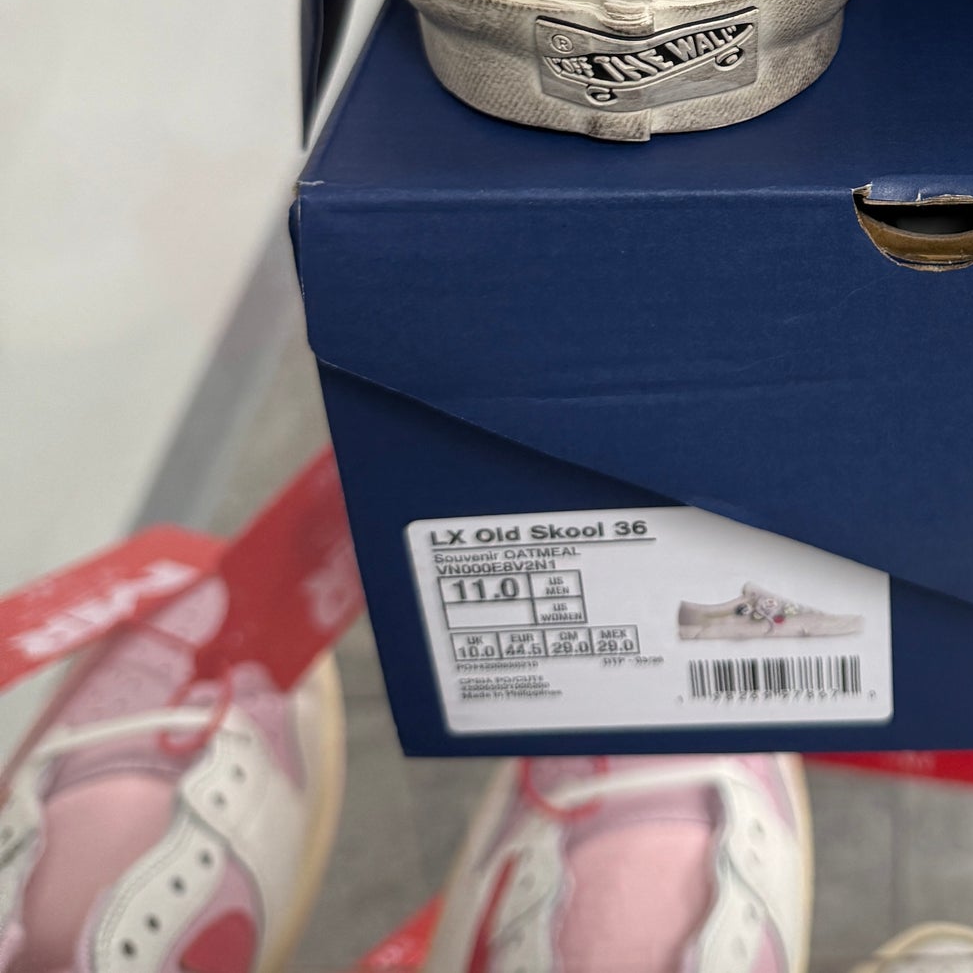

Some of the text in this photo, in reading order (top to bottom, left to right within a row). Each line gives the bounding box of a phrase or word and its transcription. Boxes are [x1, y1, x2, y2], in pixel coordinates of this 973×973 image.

[593, 48, 674, 83] THE
[430, 520, 649, 546] LX Old Skool 36
[434, 547, 581, 564] Souvenir OATMEAL
[549, 576, 565, 586] US
[452, 577, 521, 600] 11.0
[545, 586, 570, 595] MEN
[553, 602, 568, 611] US
[541, 611, 583, 622] WOMEN
[467, 635, 483, 645] UK
[510, 633, 535, 643] EUR
[559, 631, 579, 641] CM
[600, 629, 628, 639] MEX
[458, 645, 496, 659] 10.0
[505, 643, 543, 656] 44.5
[551, 641, 590, 655] 29.0
[597, 639, 635, 653] 29.0
